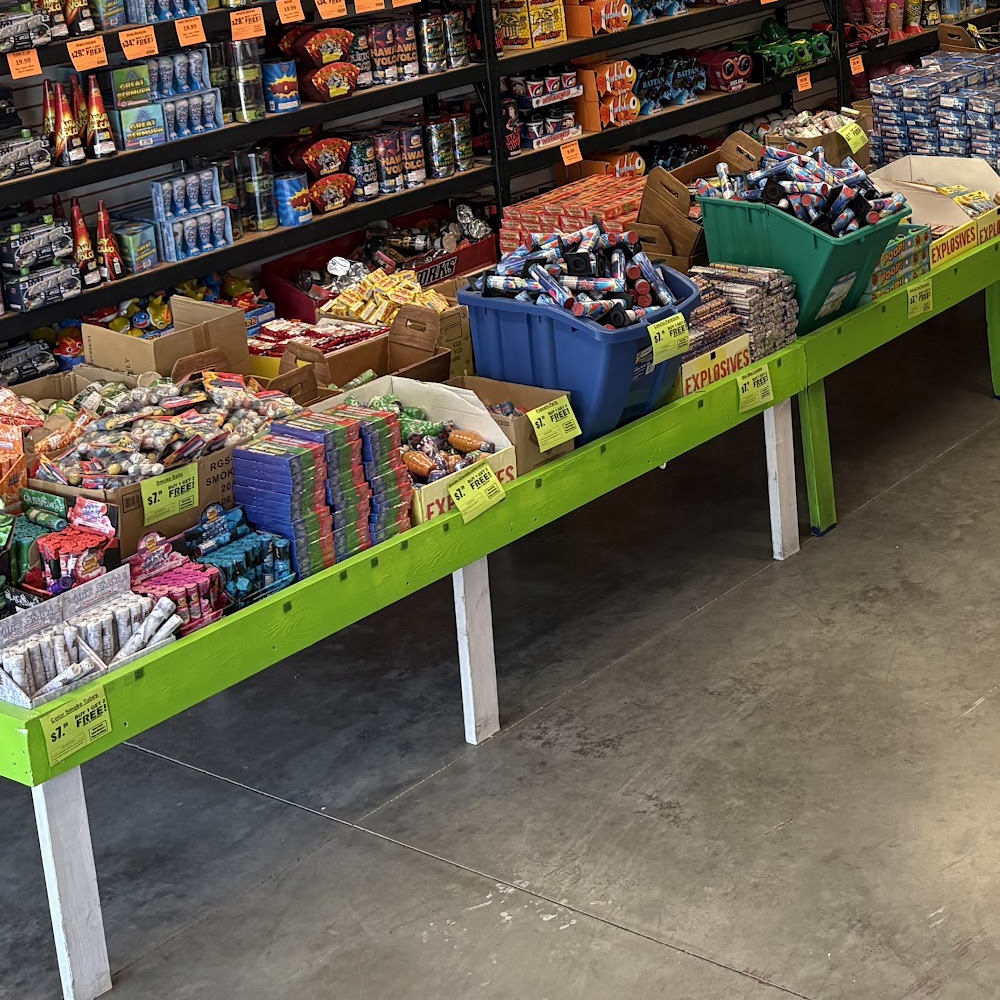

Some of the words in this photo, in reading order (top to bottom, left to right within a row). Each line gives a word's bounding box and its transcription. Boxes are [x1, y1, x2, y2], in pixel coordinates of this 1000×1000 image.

[119, 79, 145, 91] GREAT
[126, 126, 164, 140] BERMUDA
[129, 118, 157, 131] GREAT
[882, 241, 906, 266] POOP!
[931, 226, 976, 264] EXPLOSIVES
[880, 259, 903, 286] POOP!
[669, 324, 687, 338] FREE!
[685, 348, 750, 396] EXPLOSIVES
[752, 375, 769, 389] FREE!
[550, 408, 570, 423] FREE!
[156, 477, 172, 487] Smoke
[172, 473, 183, 482] Balls
[206, 468, 233, 487] SMOK
[467, 476, 476, 484] BUY
[478, 469, 486, 478] GET
[469, 471, 492, 490] FREE!
[168, 481, 195, 498] FREE!
[50, 712, 65, 723] Color
[66, 702, 83, 715] Smoke
[84, 693, 99, 705] Tubes
[74, 710, 86, 720] BUY
[91, 701, 101, 710] GET
[76, 703, 108, 728] FREE!
